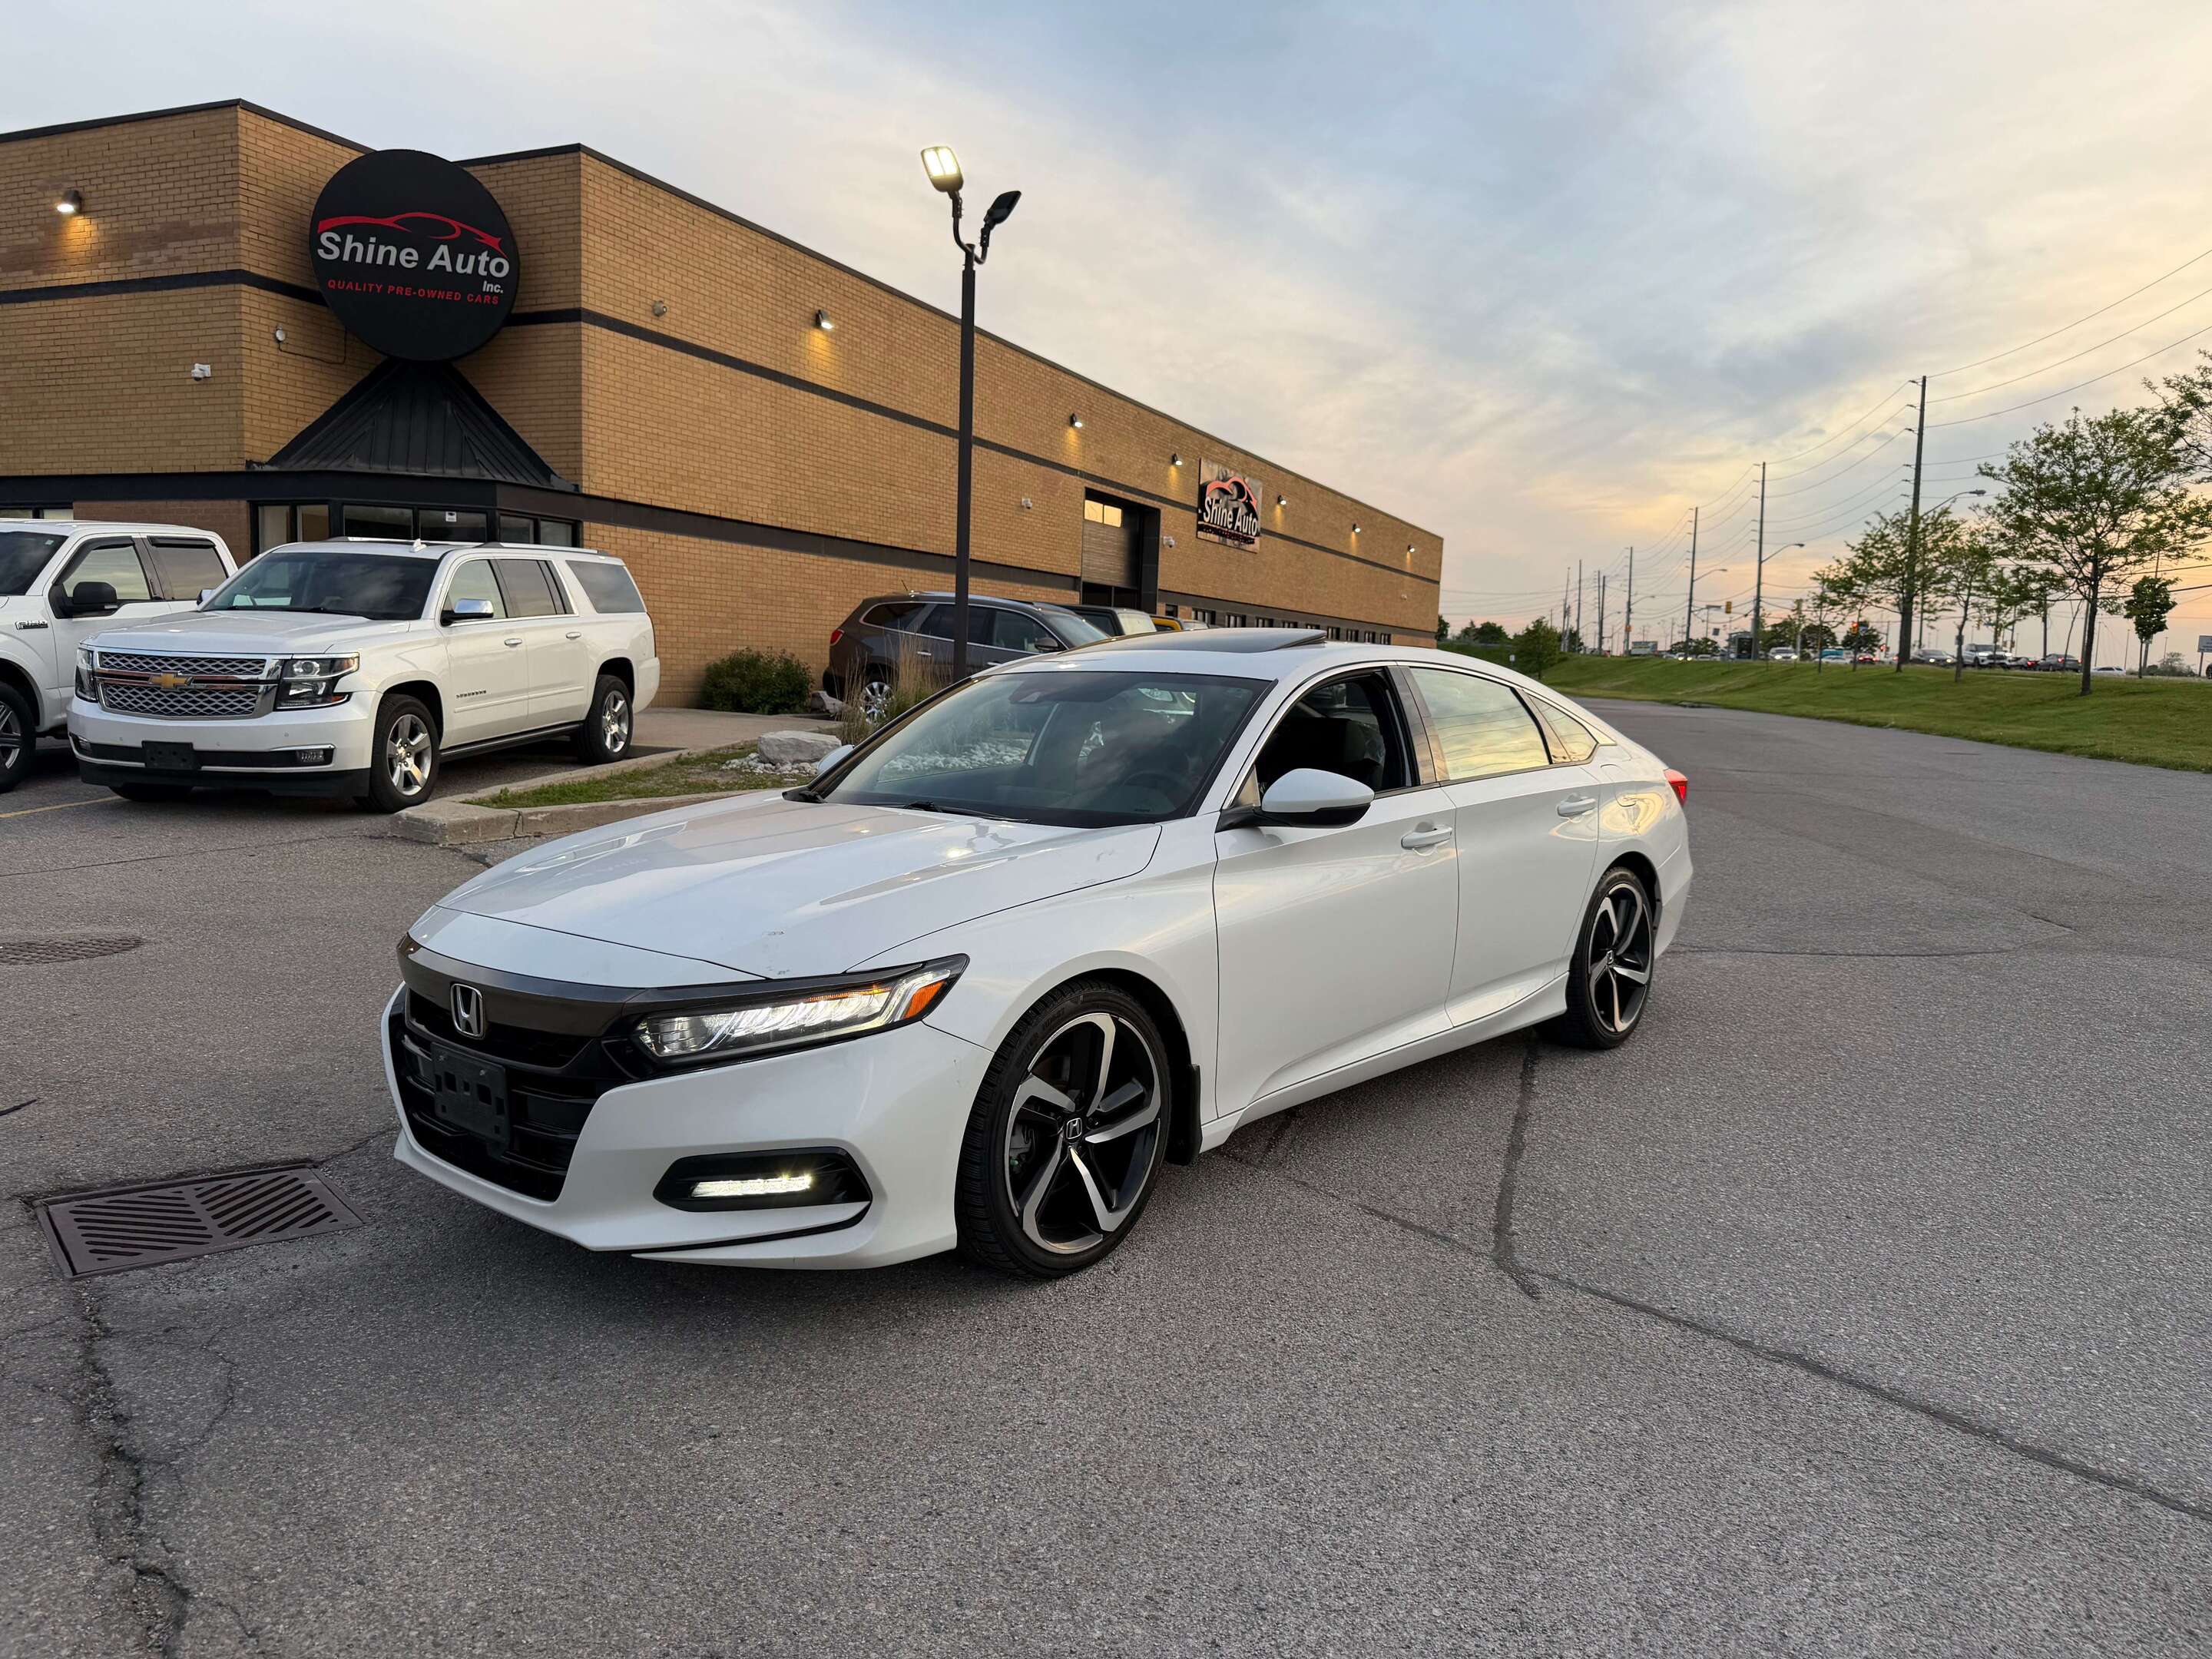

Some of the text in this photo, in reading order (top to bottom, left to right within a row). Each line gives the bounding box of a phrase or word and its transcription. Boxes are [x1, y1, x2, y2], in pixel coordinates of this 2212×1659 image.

[317, 231, 510, 278] Shine Auto
[327, 279, 499, 305] QUALITY PRE-OWNED CARS
[482, 280, 504, 294] Inc.
[1203, 496, 1233, 529] Shine
[1234, 507, 1257, 536] Auto
